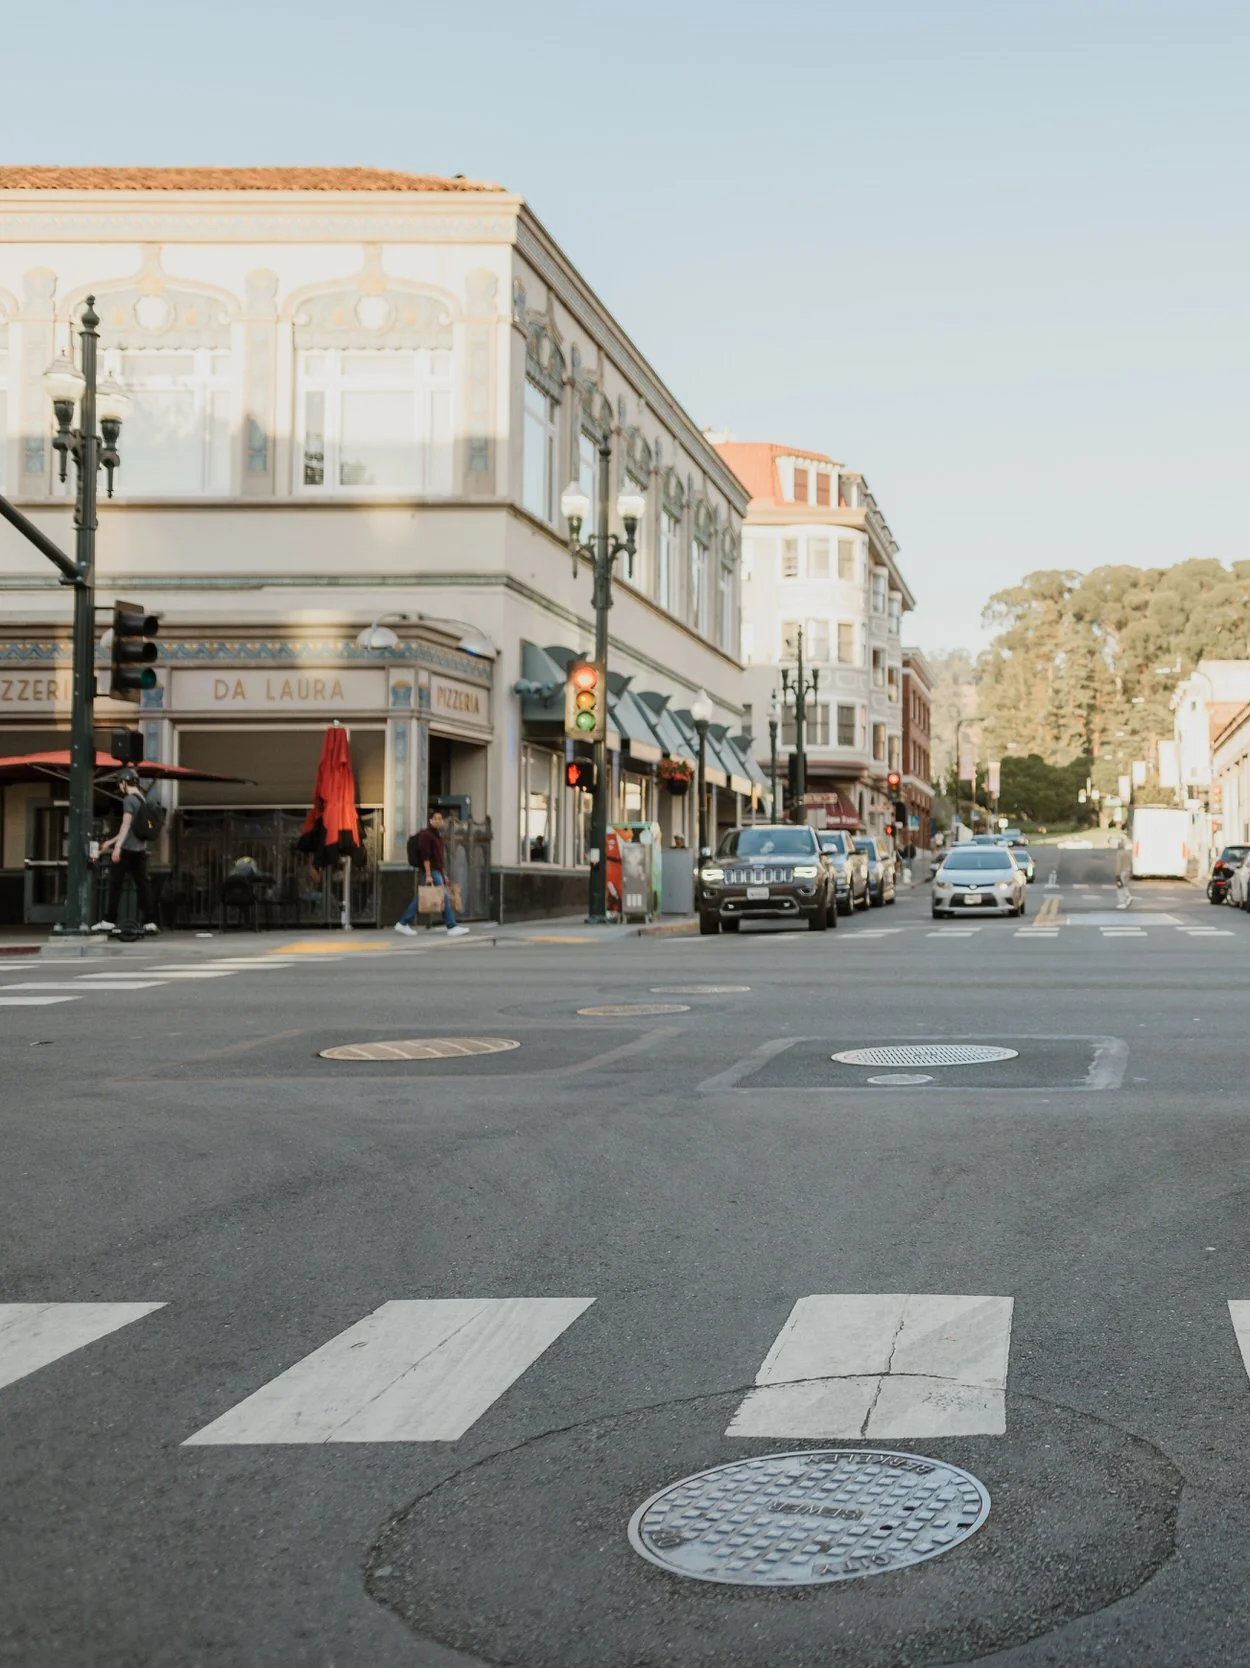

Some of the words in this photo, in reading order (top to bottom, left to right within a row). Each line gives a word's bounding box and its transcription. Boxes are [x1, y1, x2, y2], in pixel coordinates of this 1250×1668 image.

[1, 679, 69, 701] ZZERI
[213, 679, 247, 700] DA
[266, 679, 345, 701] LAURA
[436, 685, 480, 715] PIZZERIA
[806, 1453, 936, 1475] BERKELEY
[768, 1502, 861, 1521] SEWER
[820, 1552, 893, 1576] CITY
